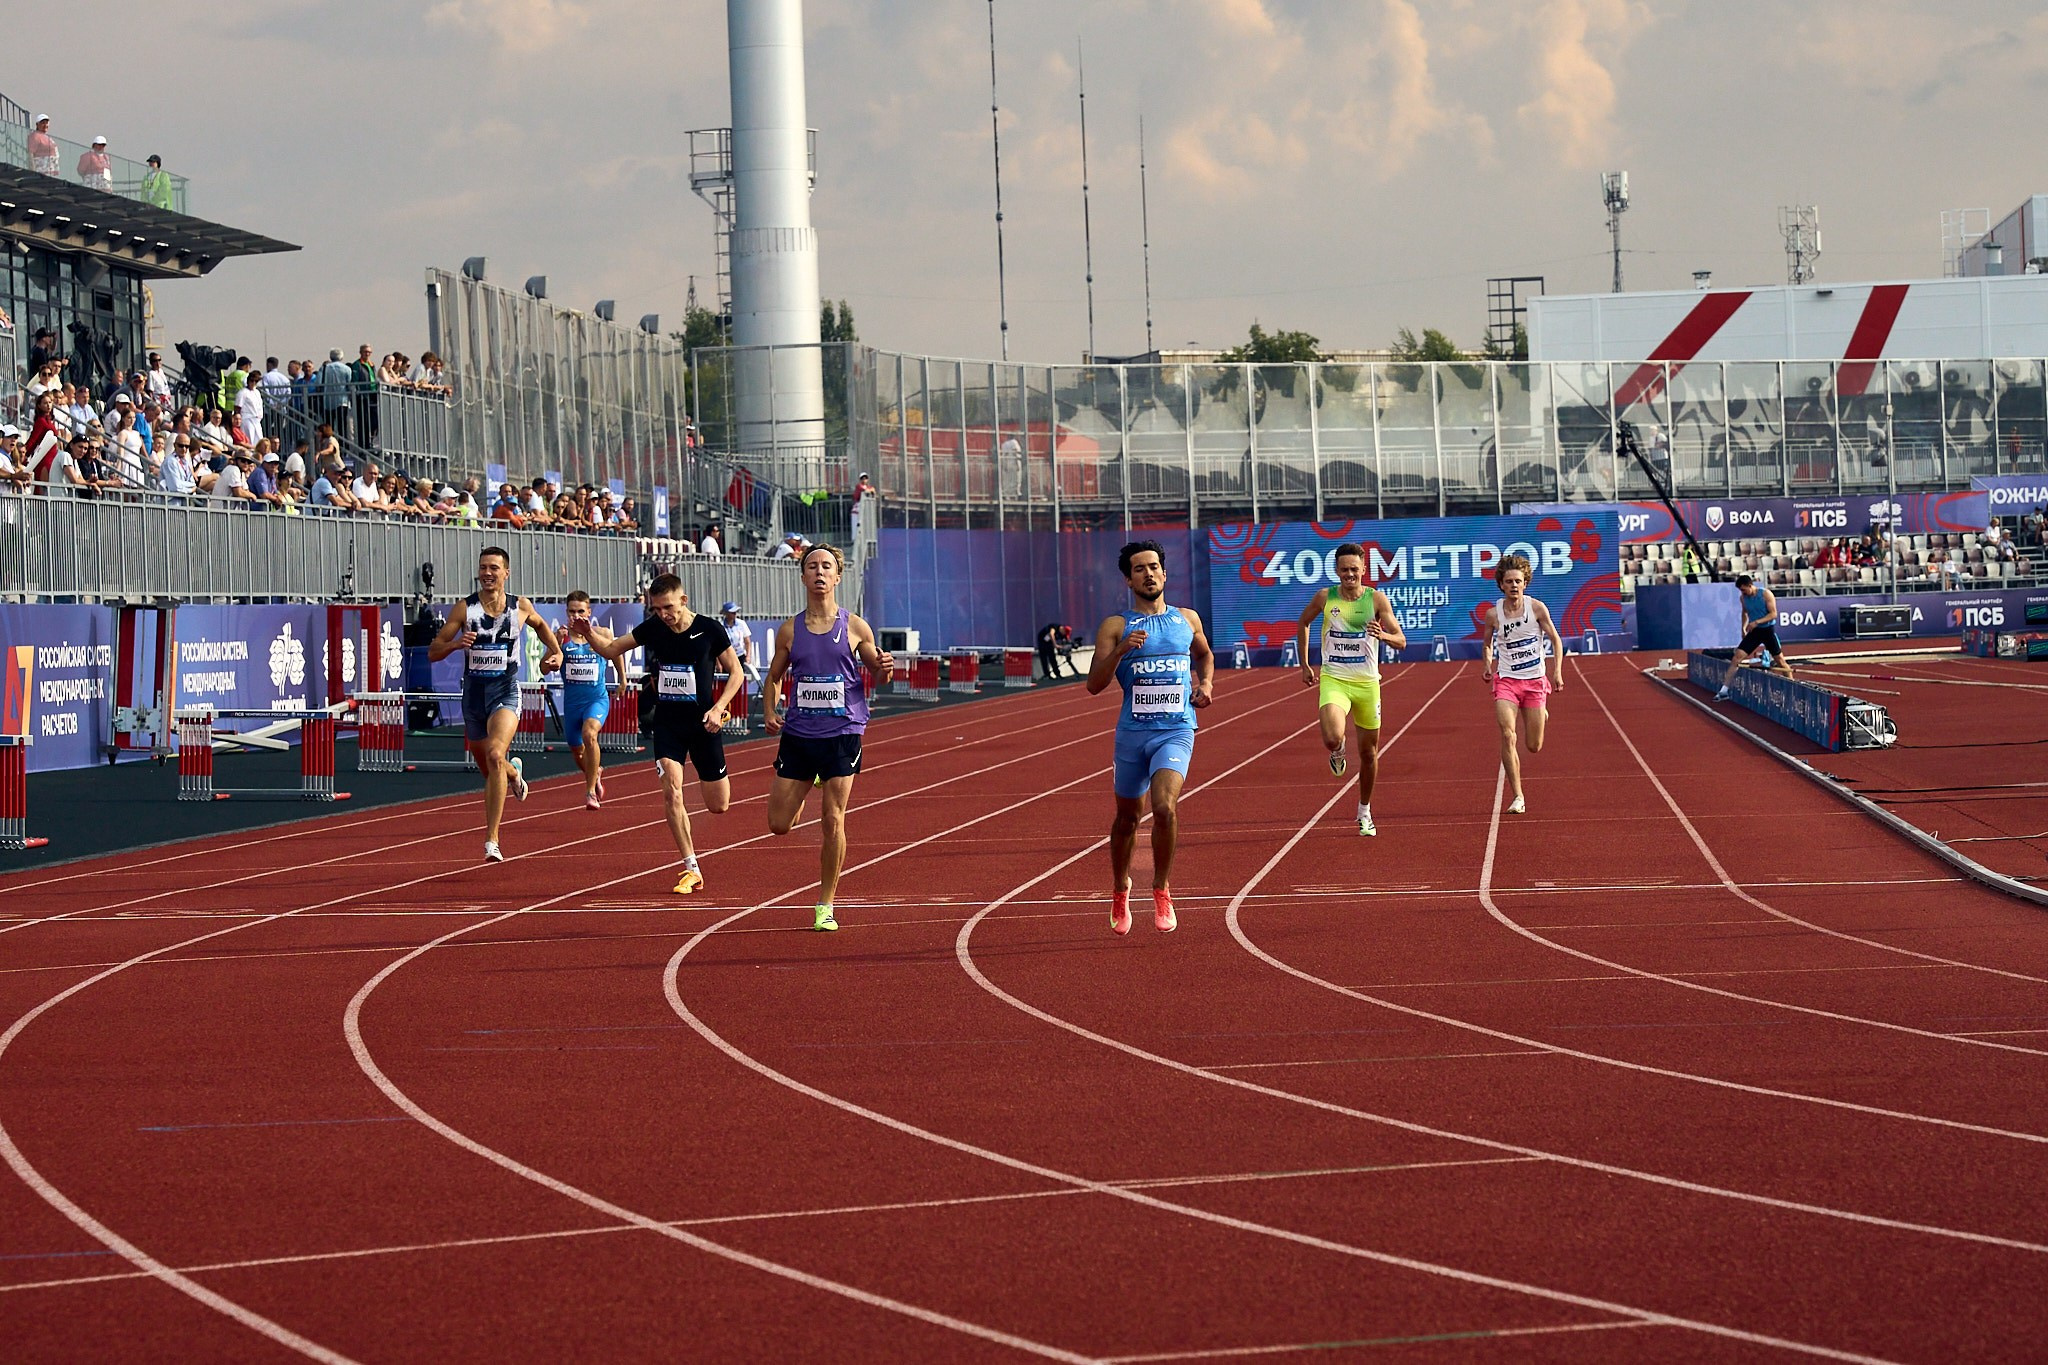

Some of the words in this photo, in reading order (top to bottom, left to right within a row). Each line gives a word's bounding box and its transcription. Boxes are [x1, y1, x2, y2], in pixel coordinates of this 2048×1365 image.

[1618, 514, 1649, 531] УРГ
[1729, 510, 1774, 525] ВФЛА
[1811, 509, 1847, 528] ПСБ
[1378, 585, 1449, 607] ЖЧИНЫ
[1395, 608, 1437, 629] АБЕГ
[1780, 611, 1827, 626] ВФЛА
[1966, 606, 2005, 627] ПСБ
[182, 637, 221, 663] РОССИЙСКАЯ
[221, 640, 249, 661] СИСТЕМА
[1333, 643, 1360, 652] УСТИНОВ
[1586, 637, 1594, 651] 1
[38, 641, 87, 669] РОССИЙСКАЯ
[87, 644, 111, 667] СИСТЕ
[472, 656, 503, 665] НИКИТИН
[570, 668, 594, 676] СМОЛИН
[1131, 659, 1188, 675] RUSSIA
[183, 671, 236, 697] МЕЖДУНАРОДНЫХ
[664, 677, 687, 688] ДУДИН
[40, 678, 105, 707] МЕЖДУНАРОДНЫХ
[802, 689, 839, 701] КУЛАКОВ
[1134, 693, 1181, 705] ВЕШНЯКОВ
[41, 712, 78, 737] РАСЧЕТОВ
